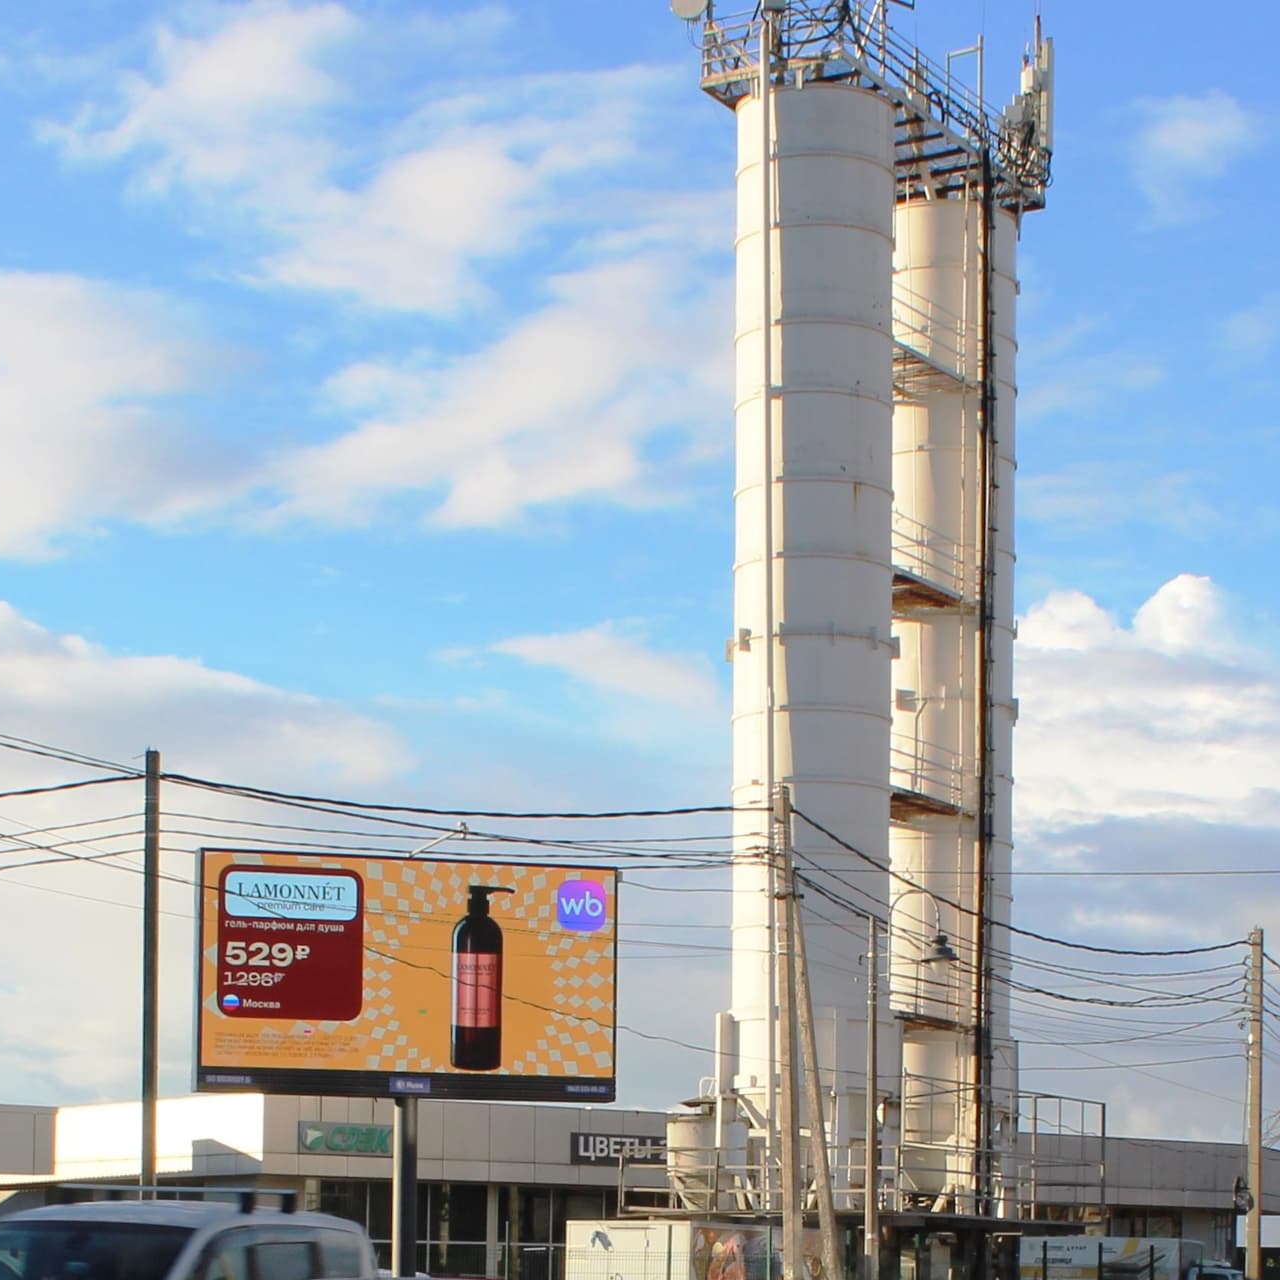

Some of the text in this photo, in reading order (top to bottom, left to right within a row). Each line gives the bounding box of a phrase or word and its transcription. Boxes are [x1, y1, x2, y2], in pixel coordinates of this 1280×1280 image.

[237, 881, 346, 901] LAMONNÉT
[257, 901, 326, 912] premium care
[560, 890, 603, 917] wb
[224, 919, 295, 931] гель-парфюм
[318, 923, 345, 933] душа
[242, 998, 281, 1009] Москва
[578, 1135, 651, 1161] ЦВЕТЫ
